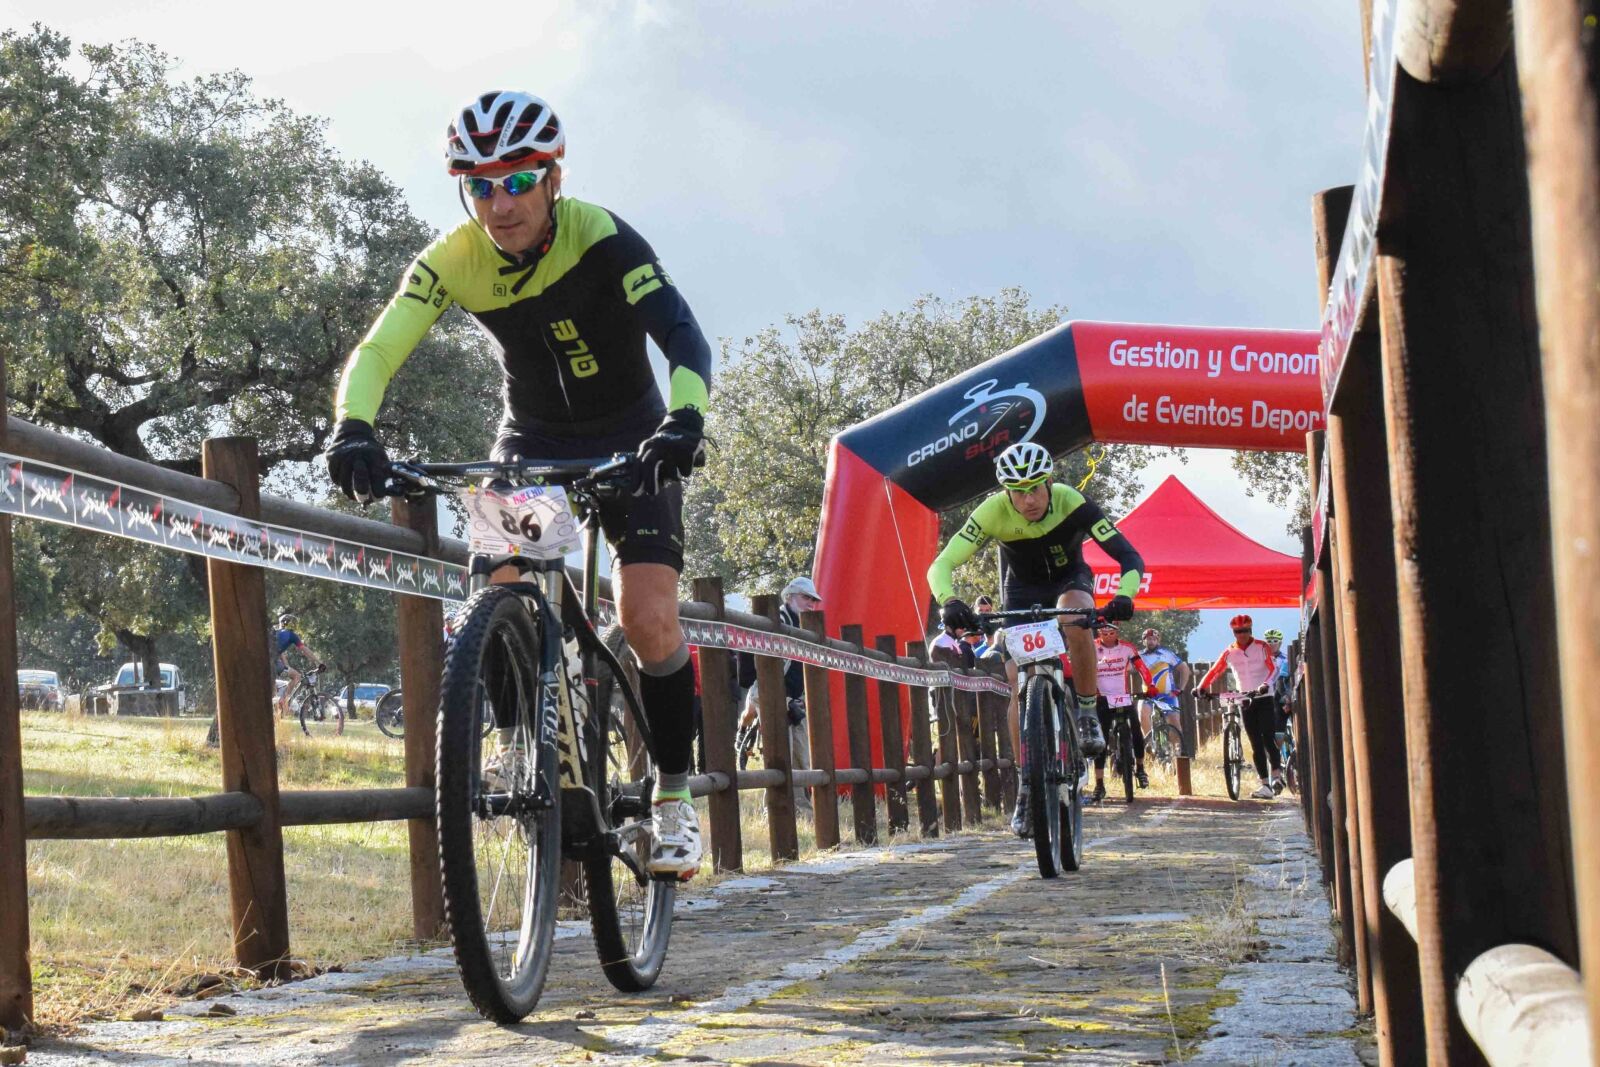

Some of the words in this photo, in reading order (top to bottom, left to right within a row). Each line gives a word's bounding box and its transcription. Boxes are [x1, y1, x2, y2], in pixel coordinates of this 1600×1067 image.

[1108, 339, 1199, 370] Gestion
[1207, 350, 1222, 377] y
[1123, 394, 1148, 423] de
[1155, 396, 1243, 427] Eventos
[907, 422, 979, 467] CRONO
[964, 429, 1009, 460] SUR
[499, 510, 542, 542] 86
[1023, 630, 1046, 652] 86
